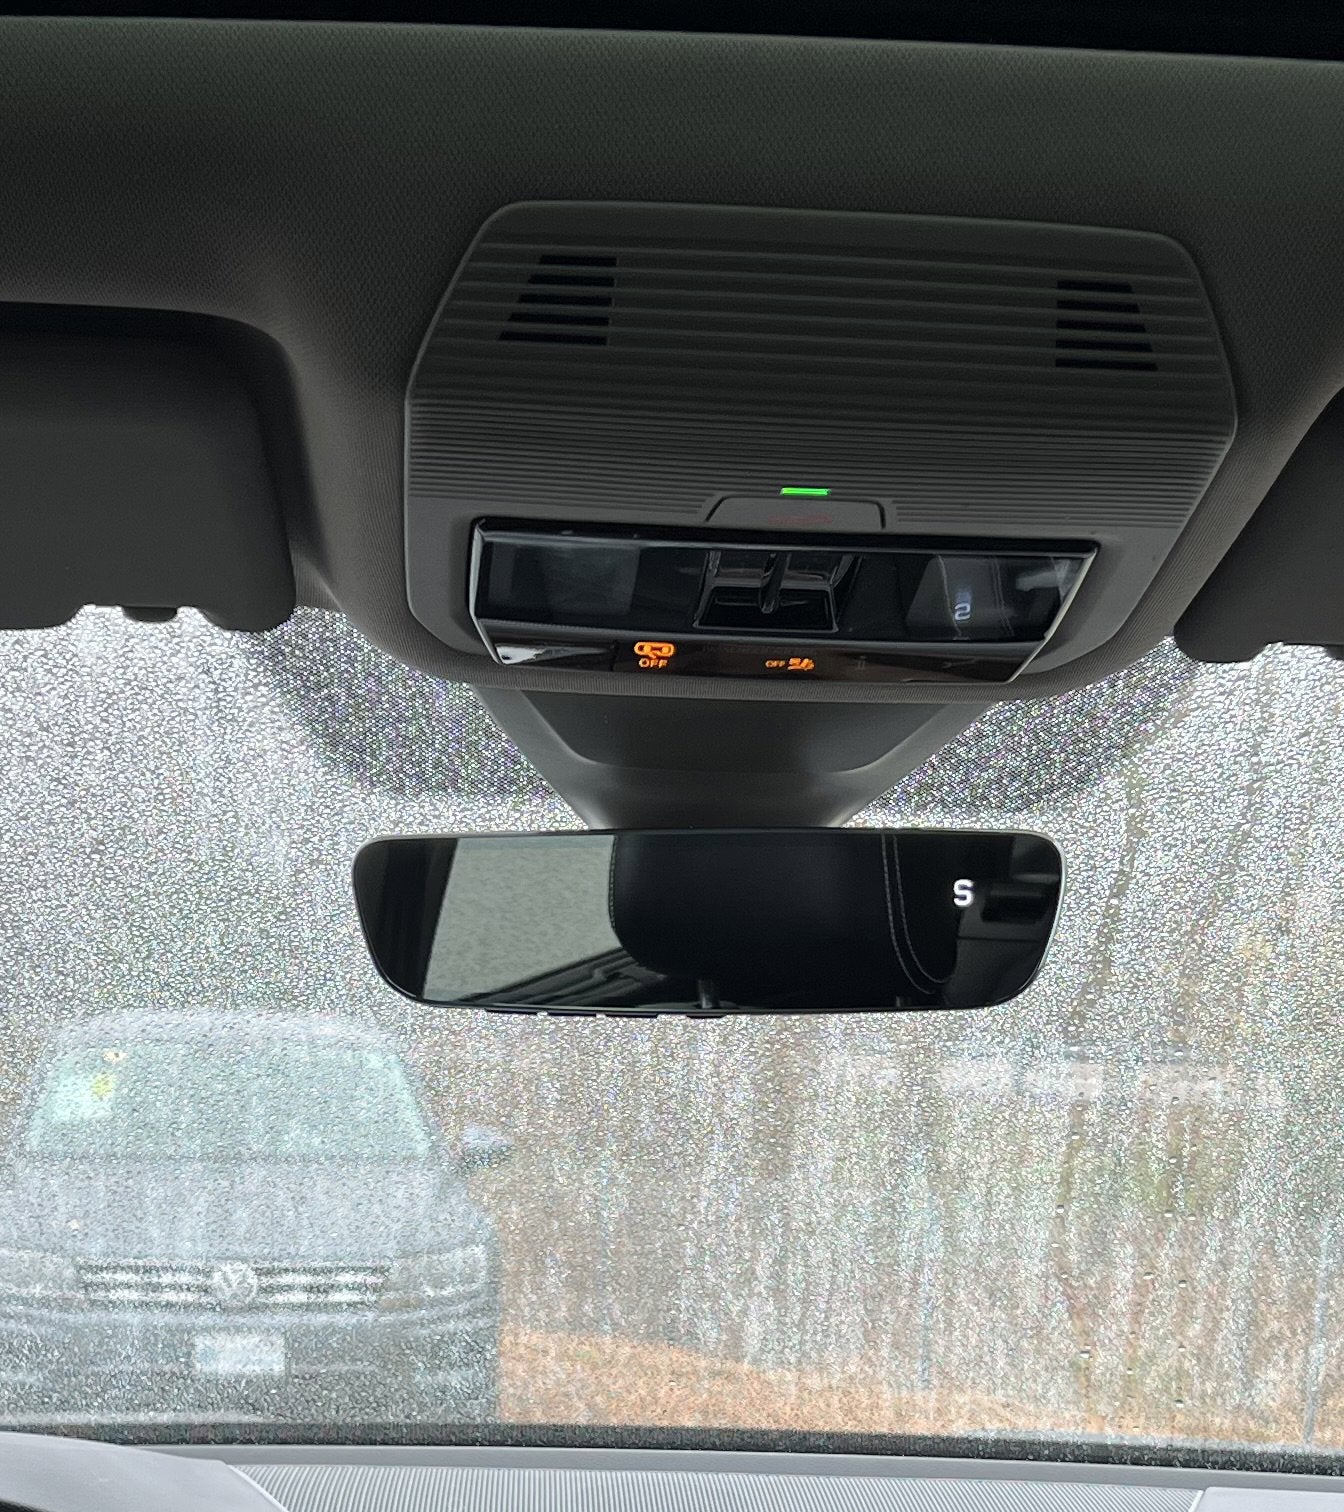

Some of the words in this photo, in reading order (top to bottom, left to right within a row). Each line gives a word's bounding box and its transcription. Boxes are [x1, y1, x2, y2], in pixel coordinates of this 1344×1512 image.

[638, 657, 668, 669] OFF
[765, 659, 786, 668] OFF
[953, 879, 973, 908] S
